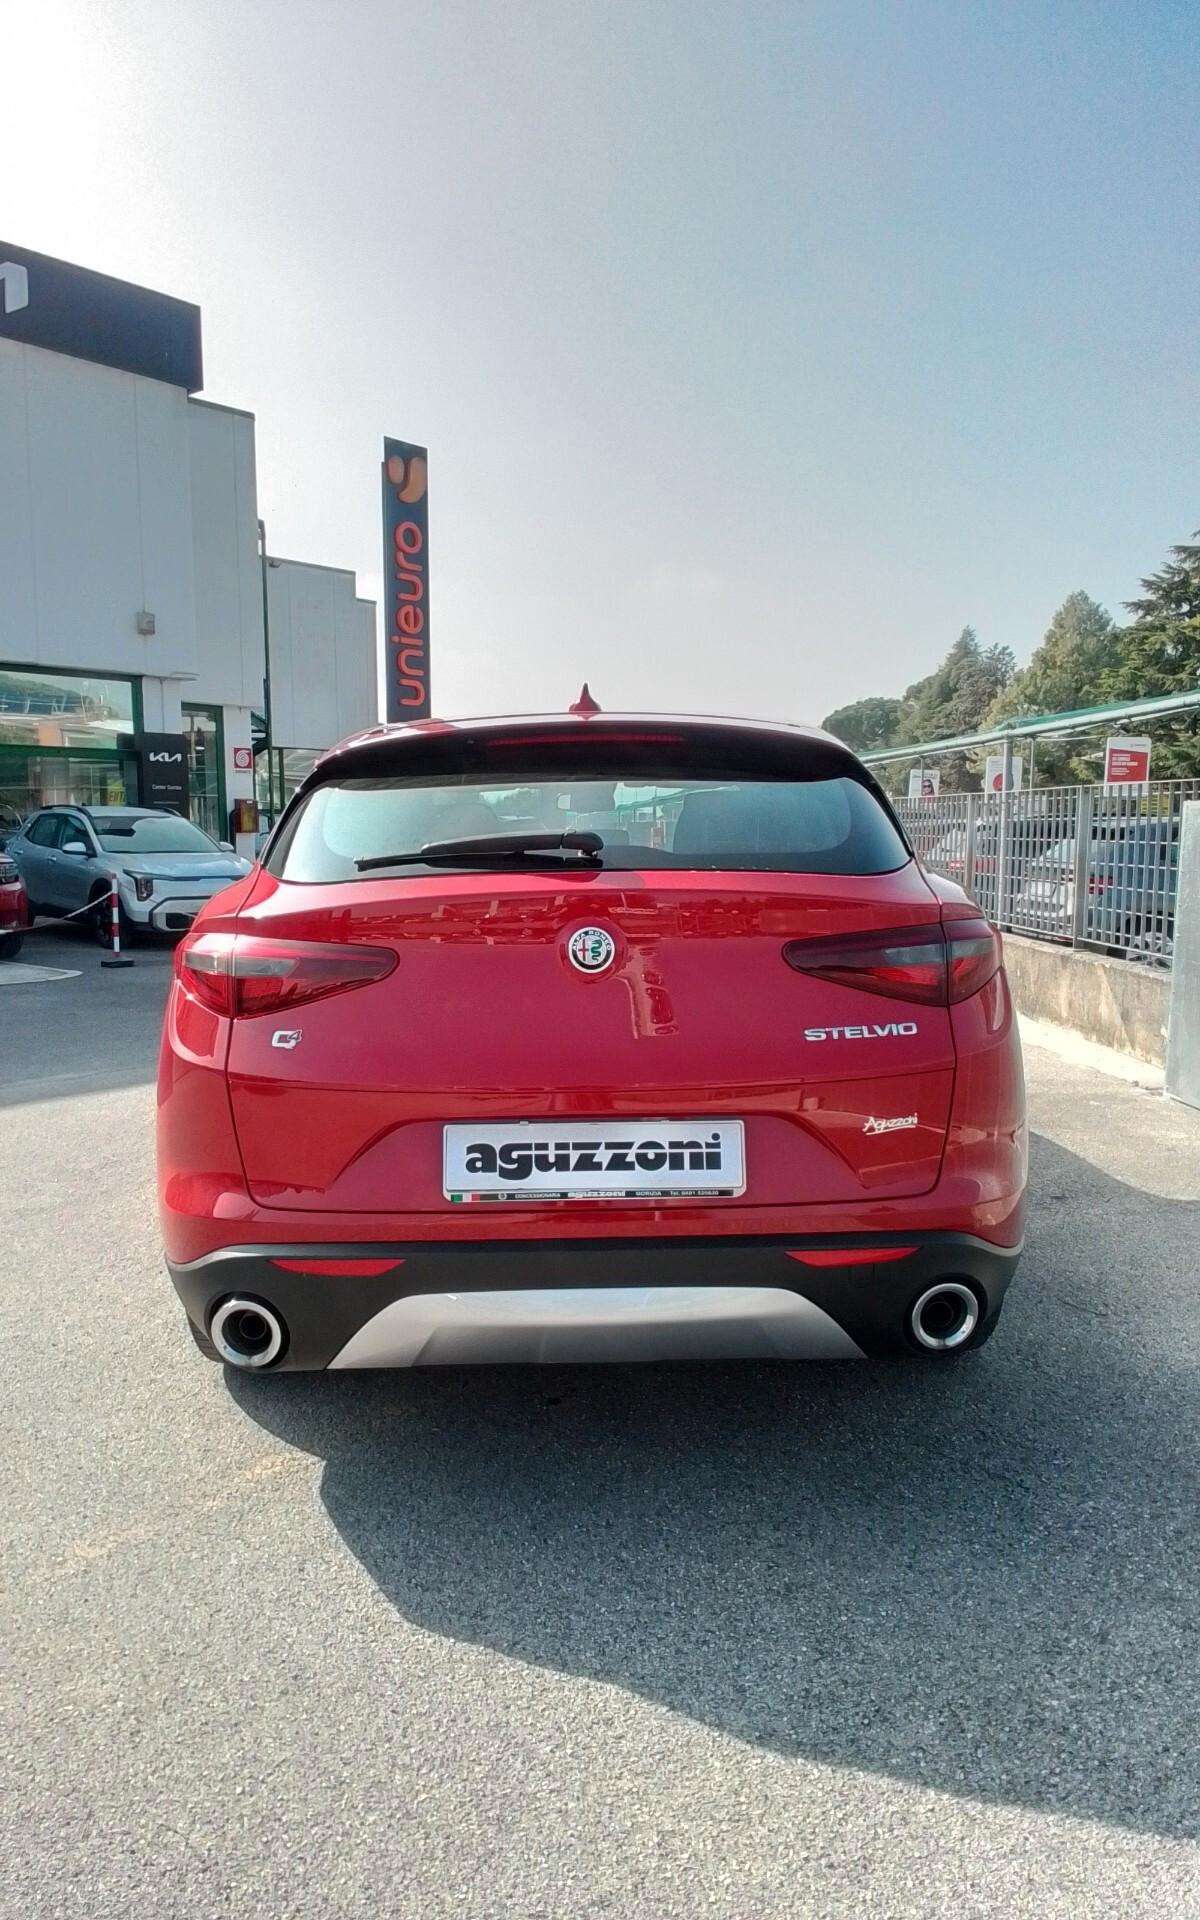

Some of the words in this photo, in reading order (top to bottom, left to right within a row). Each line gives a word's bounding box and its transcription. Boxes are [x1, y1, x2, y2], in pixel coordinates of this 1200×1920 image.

[392, 521, 425, 706] unieuro
[572, 933, 586, 951] ALFA
[588, 930, 612, 951] ROMEO
[804, 1022, 917, 1041] STELVIO
[862, 1113, 918, 1134] Aguzzoni
[465, 1133, 721, 1180] aguzzoni
